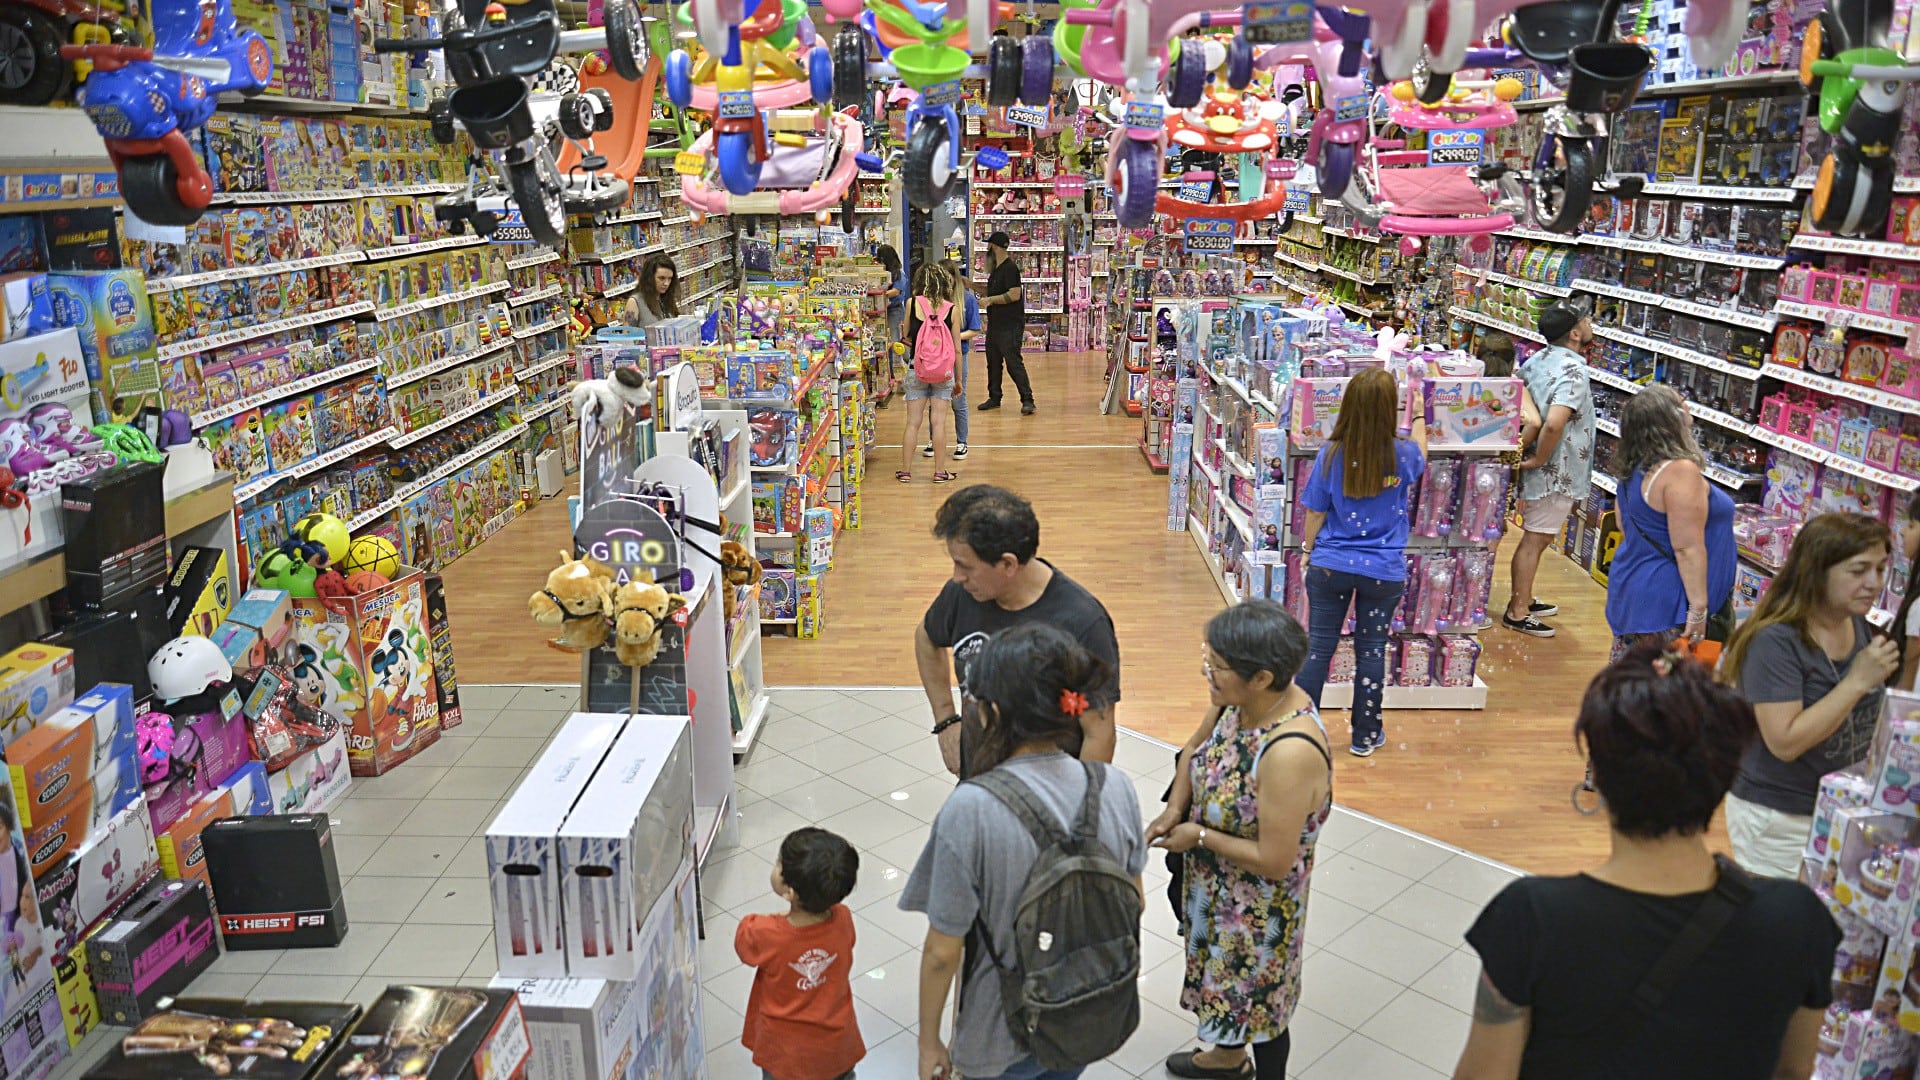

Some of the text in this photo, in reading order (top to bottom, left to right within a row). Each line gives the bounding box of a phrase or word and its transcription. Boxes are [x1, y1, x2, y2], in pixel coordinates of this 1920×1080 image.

[1432, 133, 1458, 146] CITY
[493, 227, 533, 240] $5590.0
[1188, 221, 1212, 233] CITY
[27, 379, 86, 404] LED LIGHT SCOOTER
[591, 540, 665, 563] GIRO
[171, 549, 200, 587] SCOOTER
[362, 592, 401, 614] MESUCA
[135, 701, 150, 716] FSI
[412, 701, 438, 722] HARD
[444, 709, 460, 719] XXL
[345, 735, 375, 751] ARD
[41, 774, 68, 801] SCOOTER
[35, 834, 64, 863] SCOOTER
[243, 915, 325, 929] HEIST FSI
[132, 915, 191, 979] HEIST
